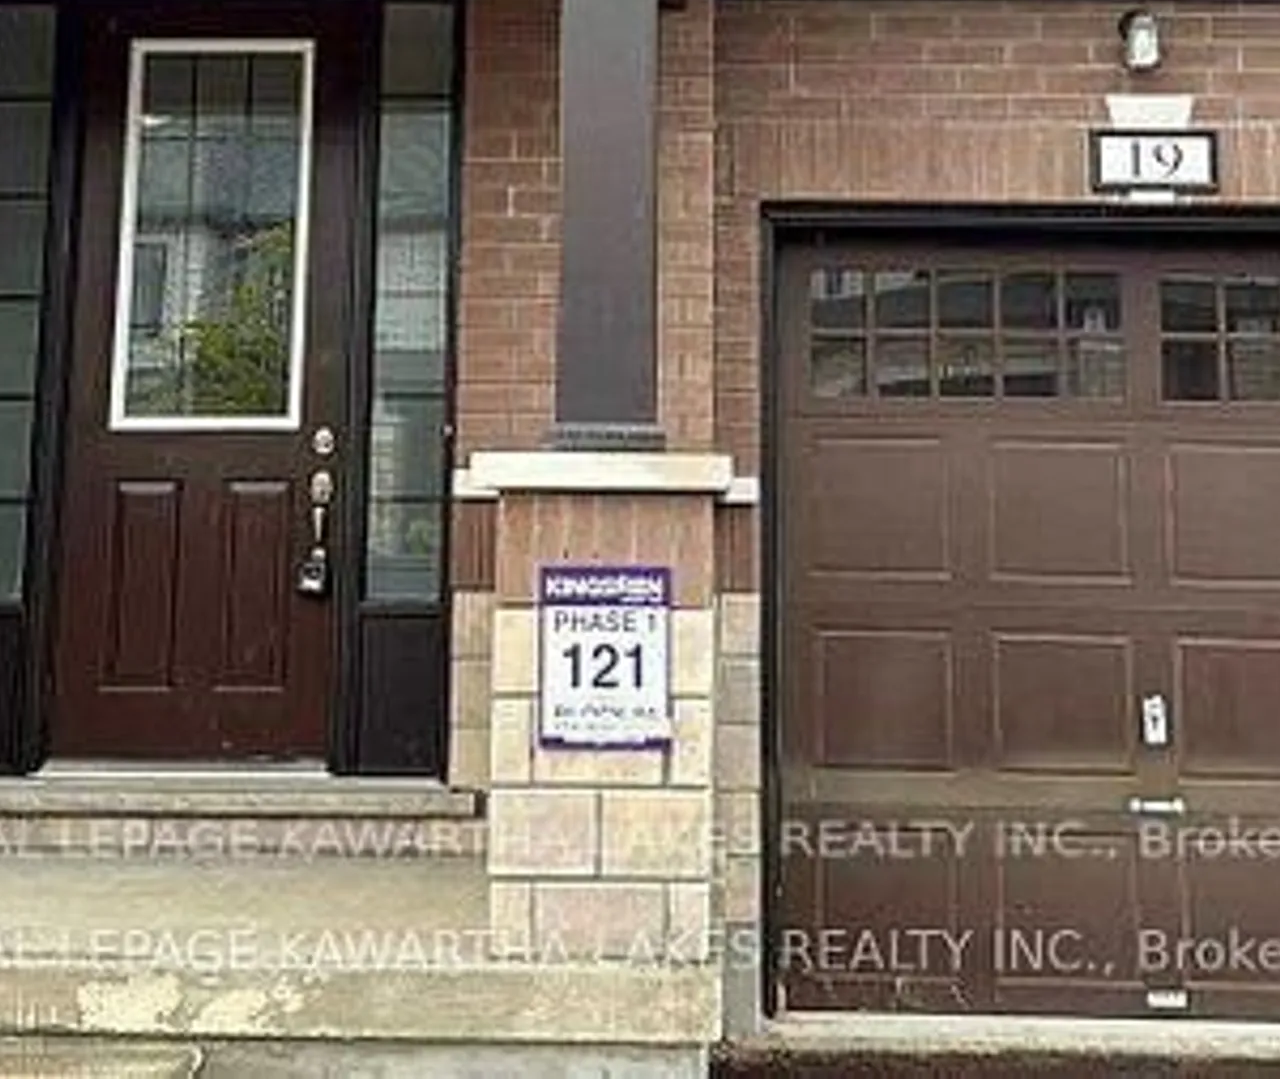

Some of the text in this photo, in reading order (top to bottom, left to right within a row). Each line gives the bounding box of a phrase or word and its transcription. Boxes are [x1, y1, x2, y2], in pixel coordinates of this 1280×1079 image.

[1130, 139, 1184, 178] 19
[554, 611, 636, 633] PHASE
[562, 643, 642, 689] 121
